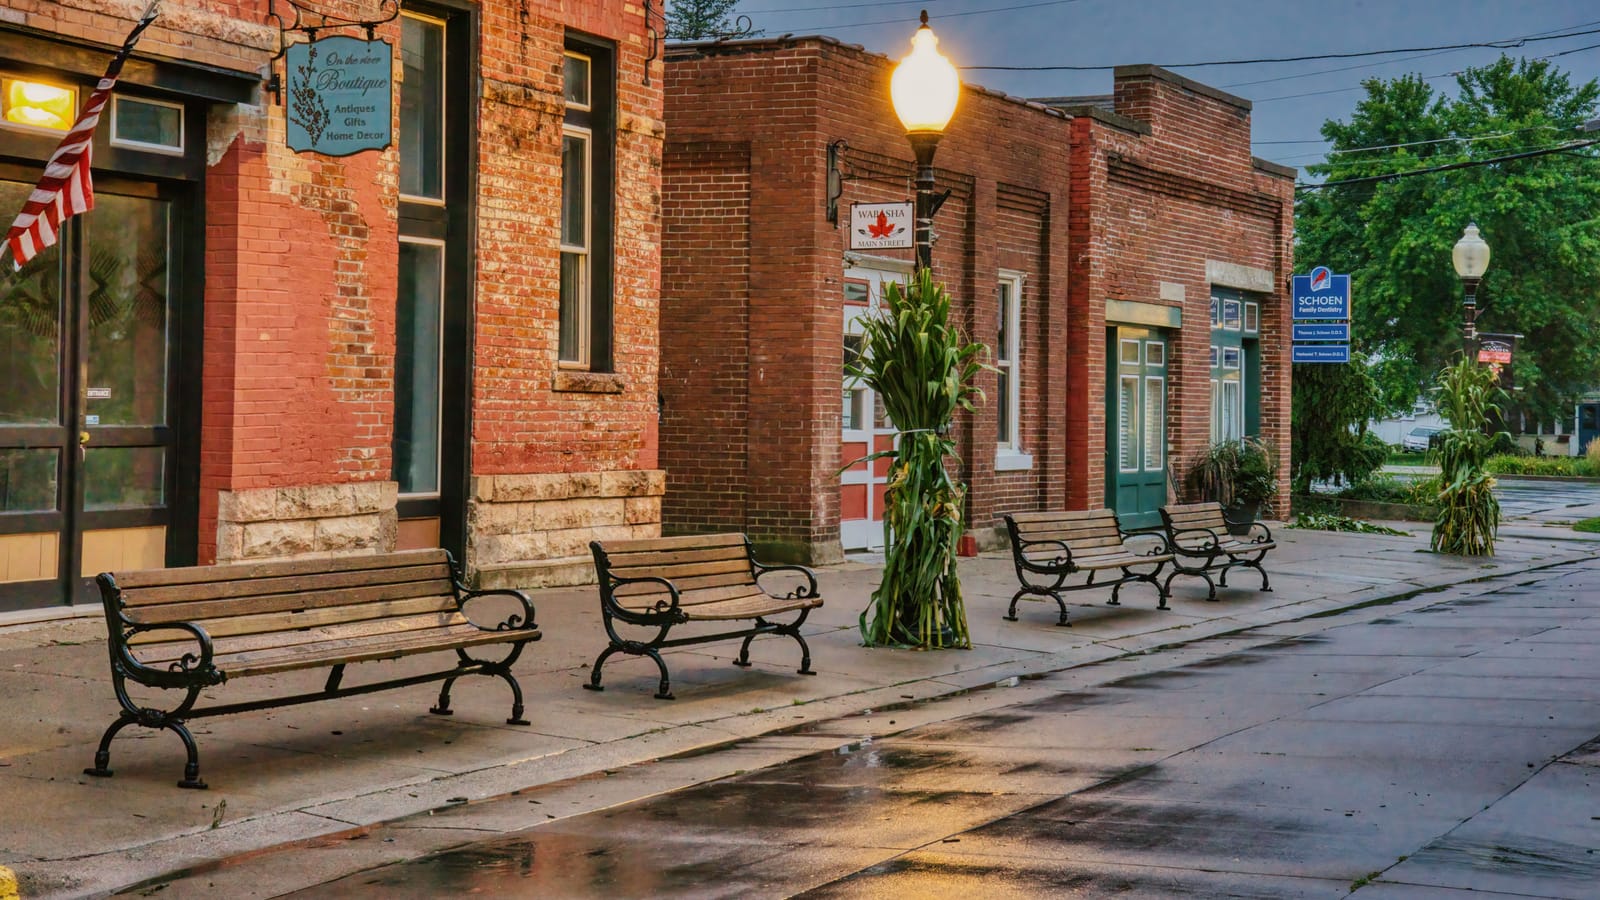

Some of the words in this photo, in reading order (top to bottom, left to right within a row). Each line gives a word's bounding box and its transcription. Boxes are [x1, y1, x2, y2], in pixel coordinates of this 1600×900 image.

[326, 52, 343, 66] On
[345, 54, 358, 65] the
[359, 56, 382, 65] river
[316, 69, 387, 97] Boutique
[334, 104, 376, 114] Antiques
[344, 117, 366, 127] Gifts
[326, 131, 354, 141] Home
[356, 131, 385, 140] Decor
[858, 209, 905, 218] WABSHA
[1298, 296, 1343, 305] SCHOEN
